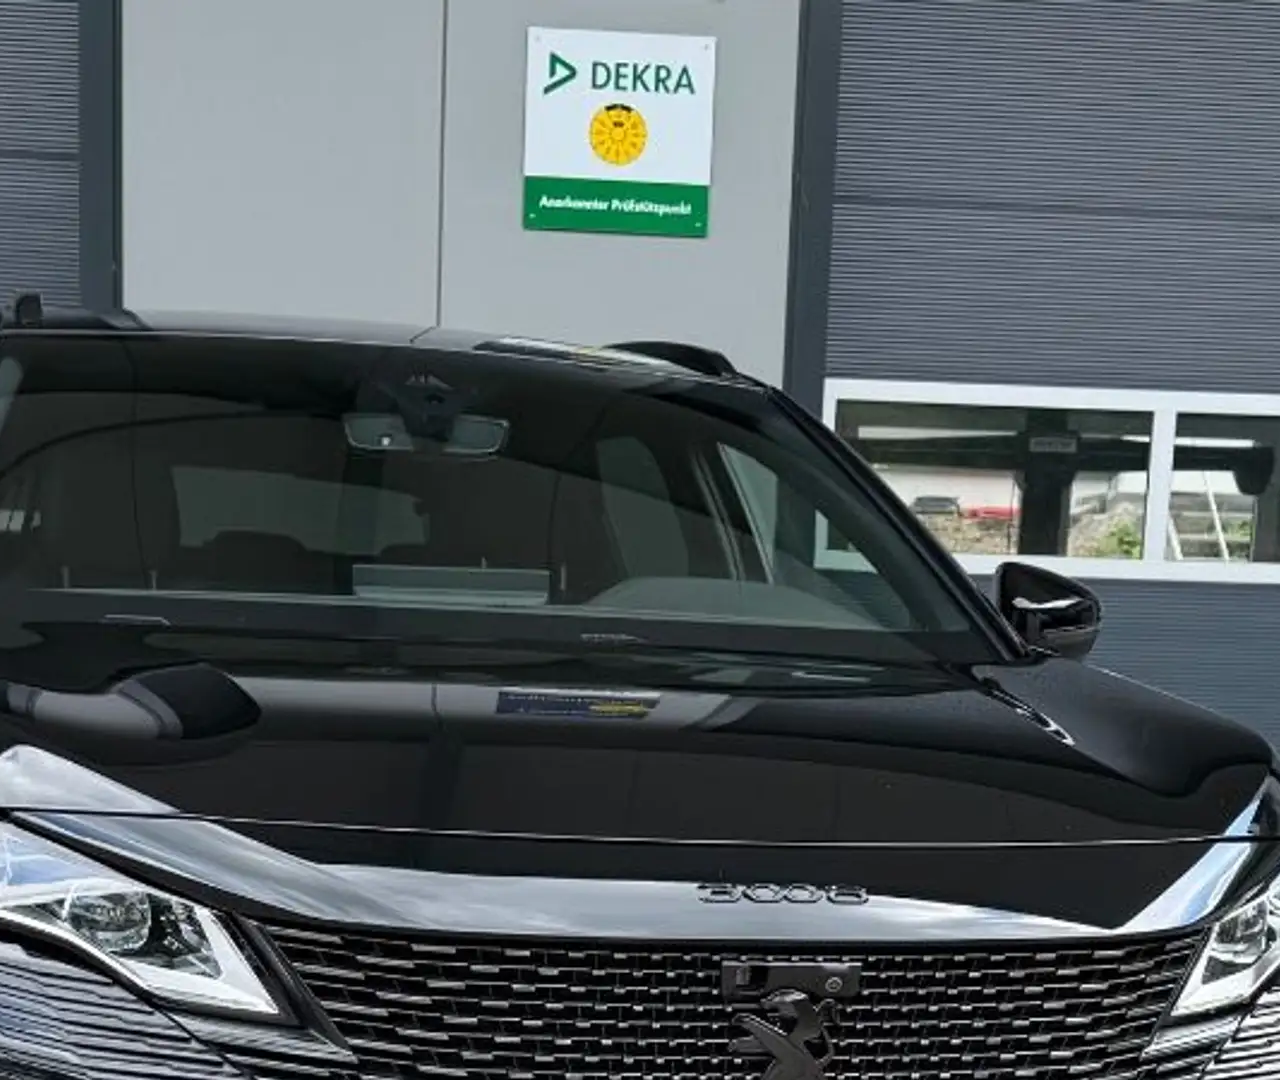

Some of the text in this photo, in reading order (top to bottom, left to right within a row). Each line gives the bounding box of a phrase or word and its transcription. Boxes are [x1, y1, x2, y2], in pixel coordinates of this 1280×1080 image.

[591, 60, 696, 95] DEKRA
[538, 194, 693, 217] Anerkannter Prüfstützpunkt
[696, 882, 870, 905] 3008
